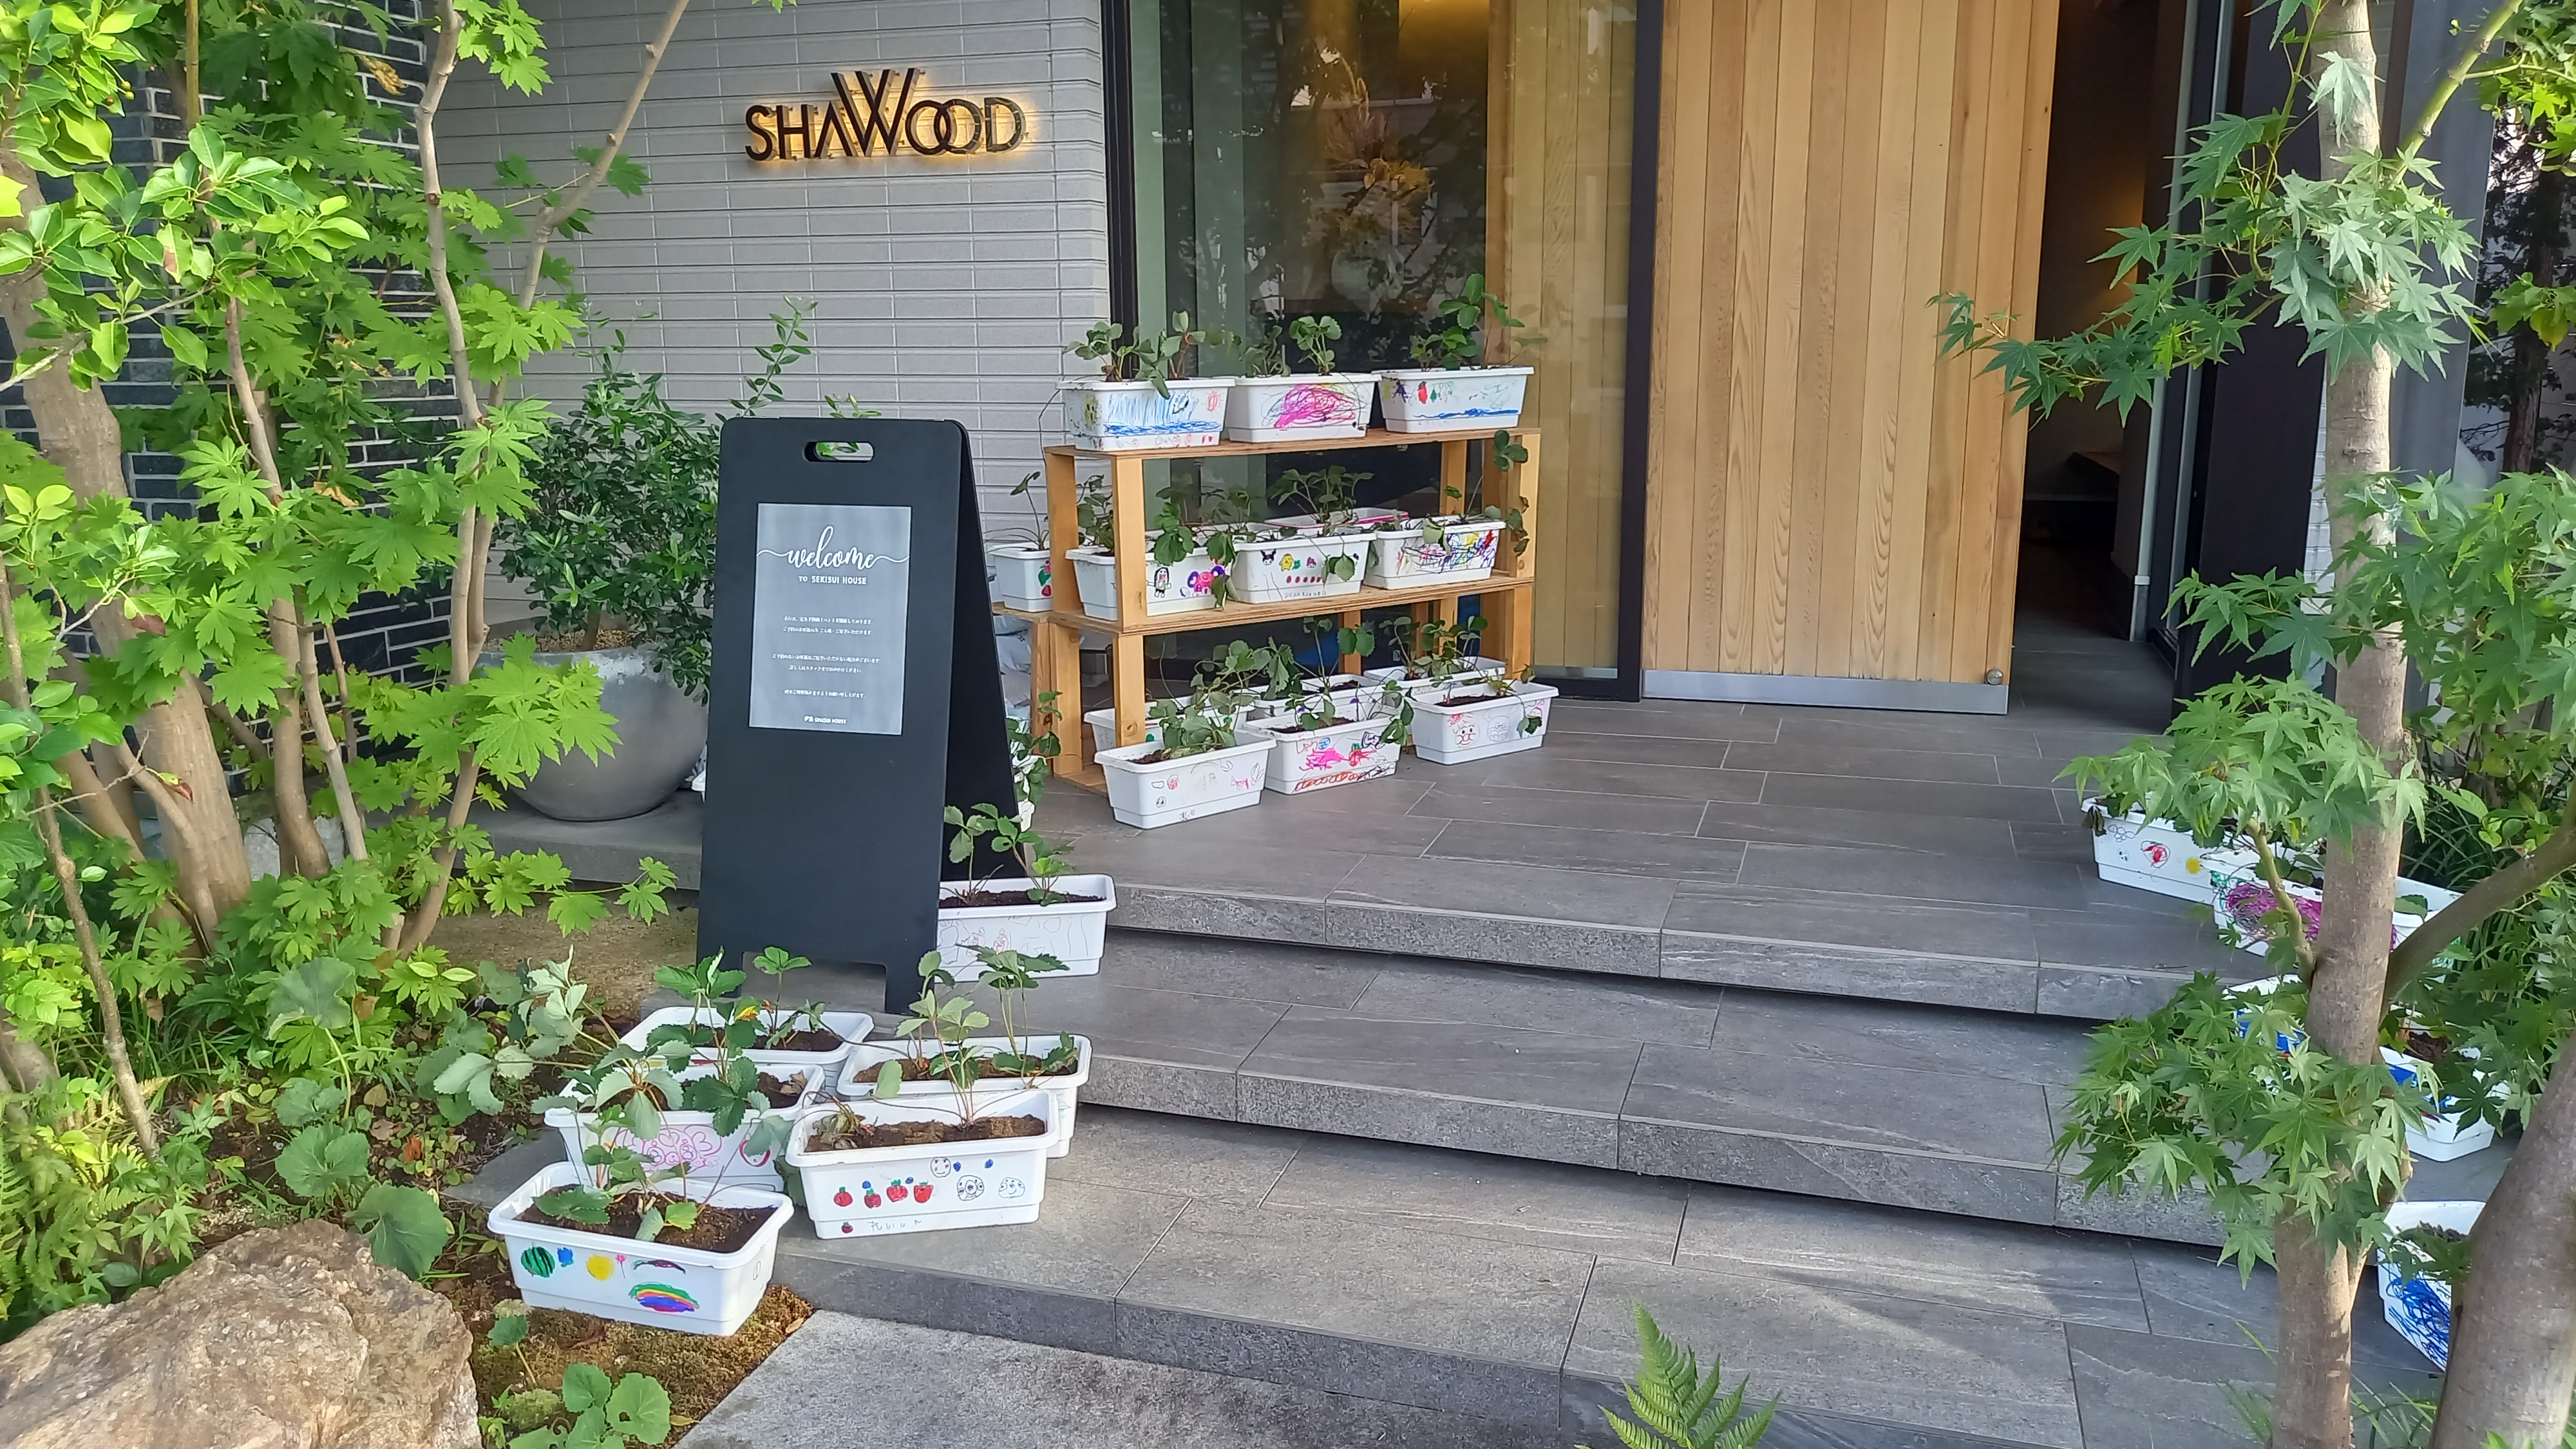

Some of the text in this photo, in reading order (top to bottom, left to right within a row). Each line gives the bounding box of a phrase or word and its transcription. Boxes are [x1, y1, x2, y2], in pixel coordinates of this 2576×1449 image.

[745, 68, 1026, 161] SHAWOOD
[786, 526, 875, 569] welcome
[811, 575, 839, 583] SEKISUI
[842, 576, 867, 585] HOUSE
